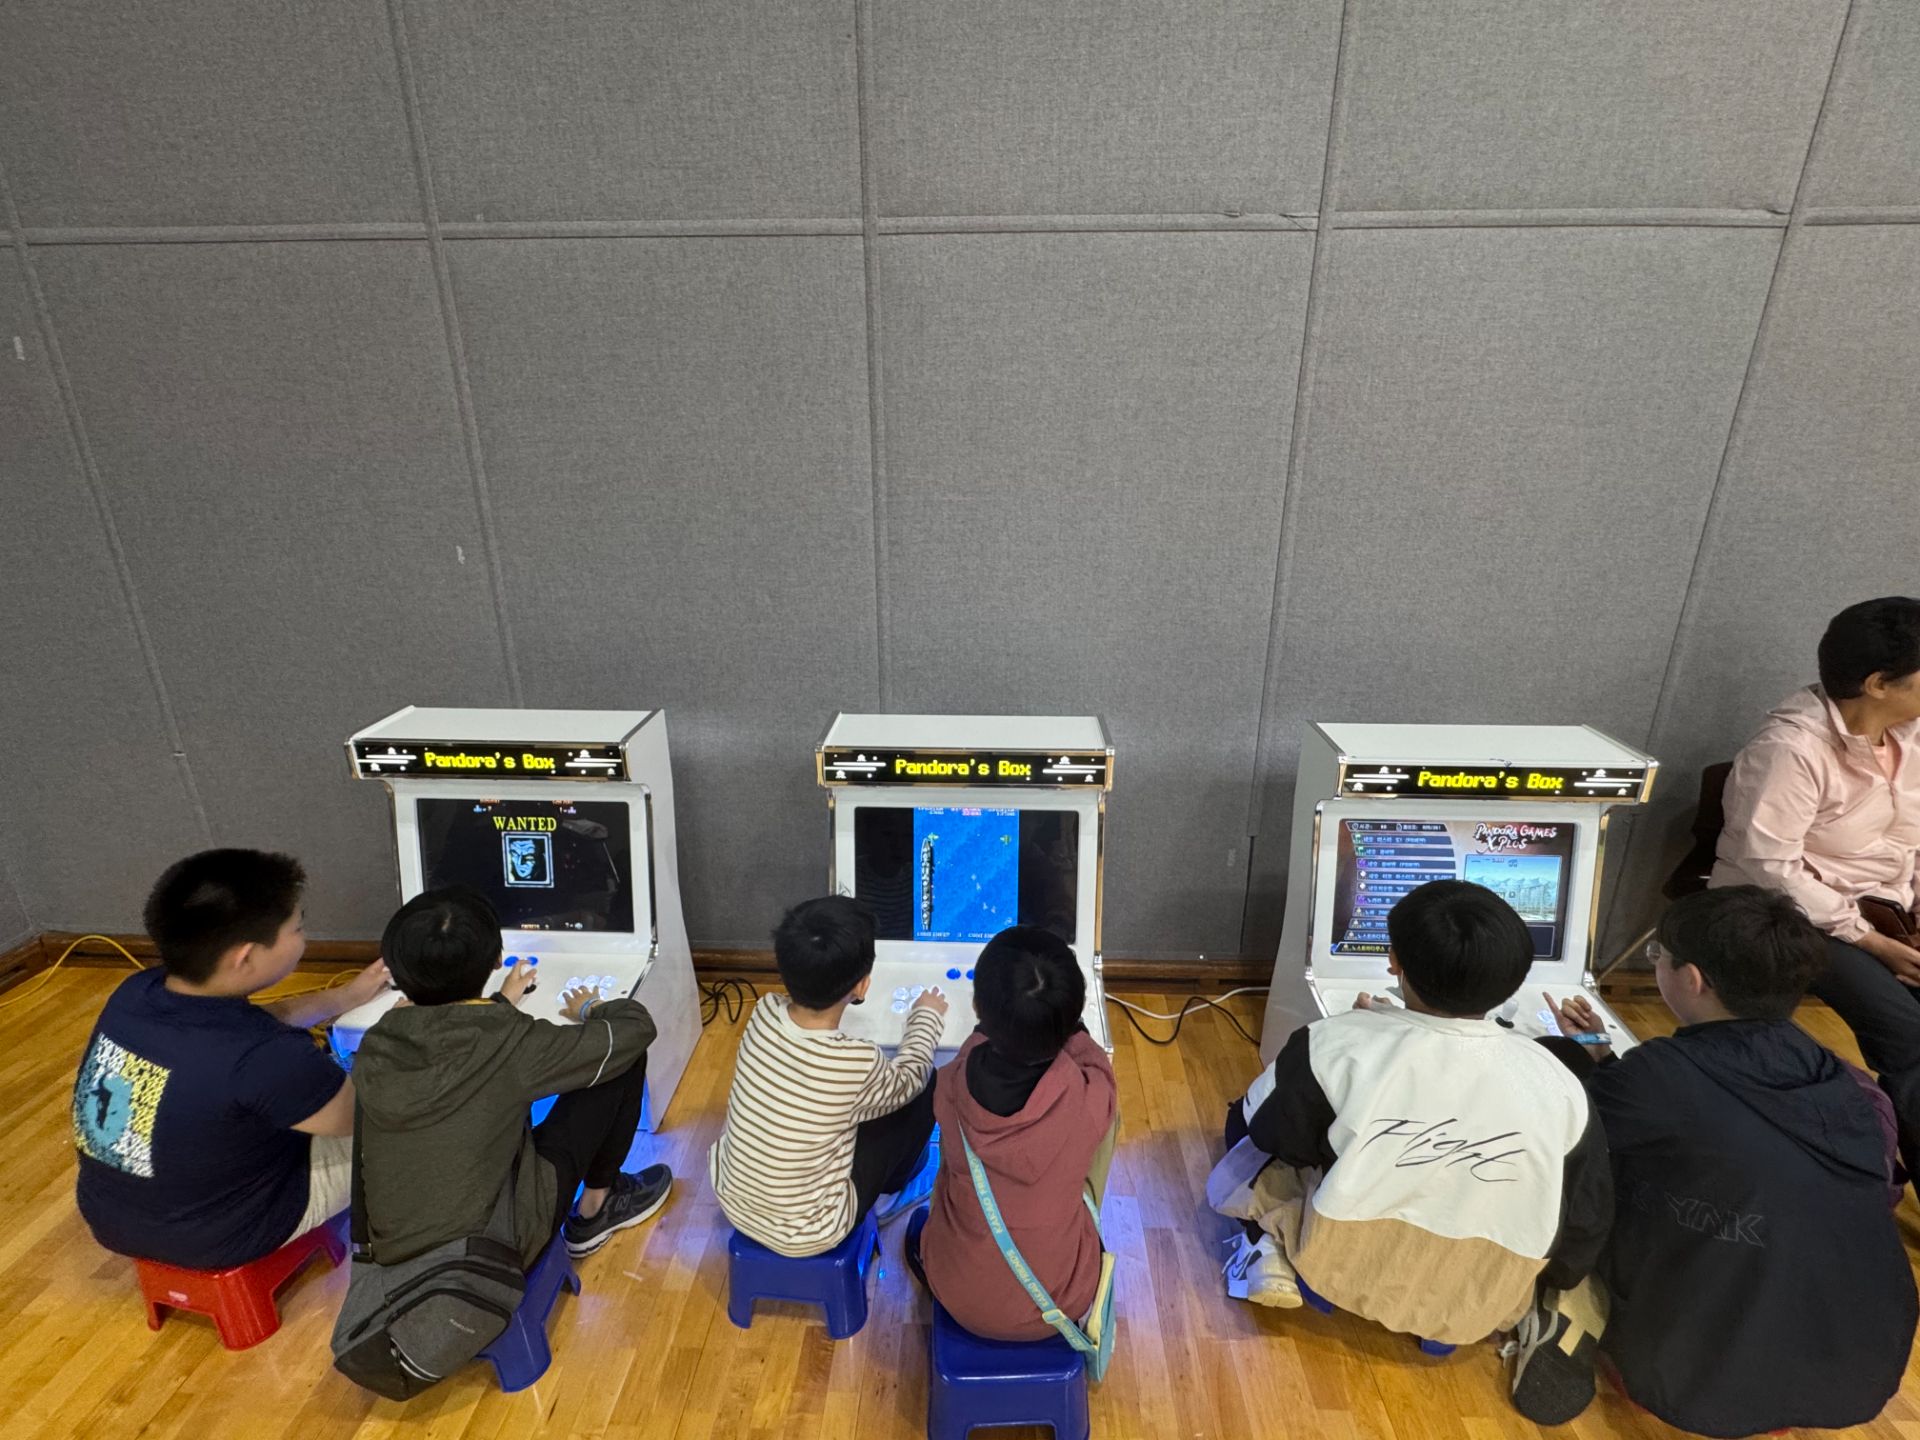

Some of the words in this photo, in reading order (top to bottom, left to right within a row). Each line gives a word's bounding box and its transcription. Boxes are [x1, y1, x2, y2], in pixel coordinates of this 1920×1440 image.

[424, 752, 516, 769] Pandora's
[522, 753, 556, 769] Box
[895, 759, 990, 775] Pandora's
[998, 760, 1032, 776] Box
[1418, 771, 1519, 789] Pandora's
[1526, 773, 1564, 789] Box
[492, 816, 557, 831] WANTED
